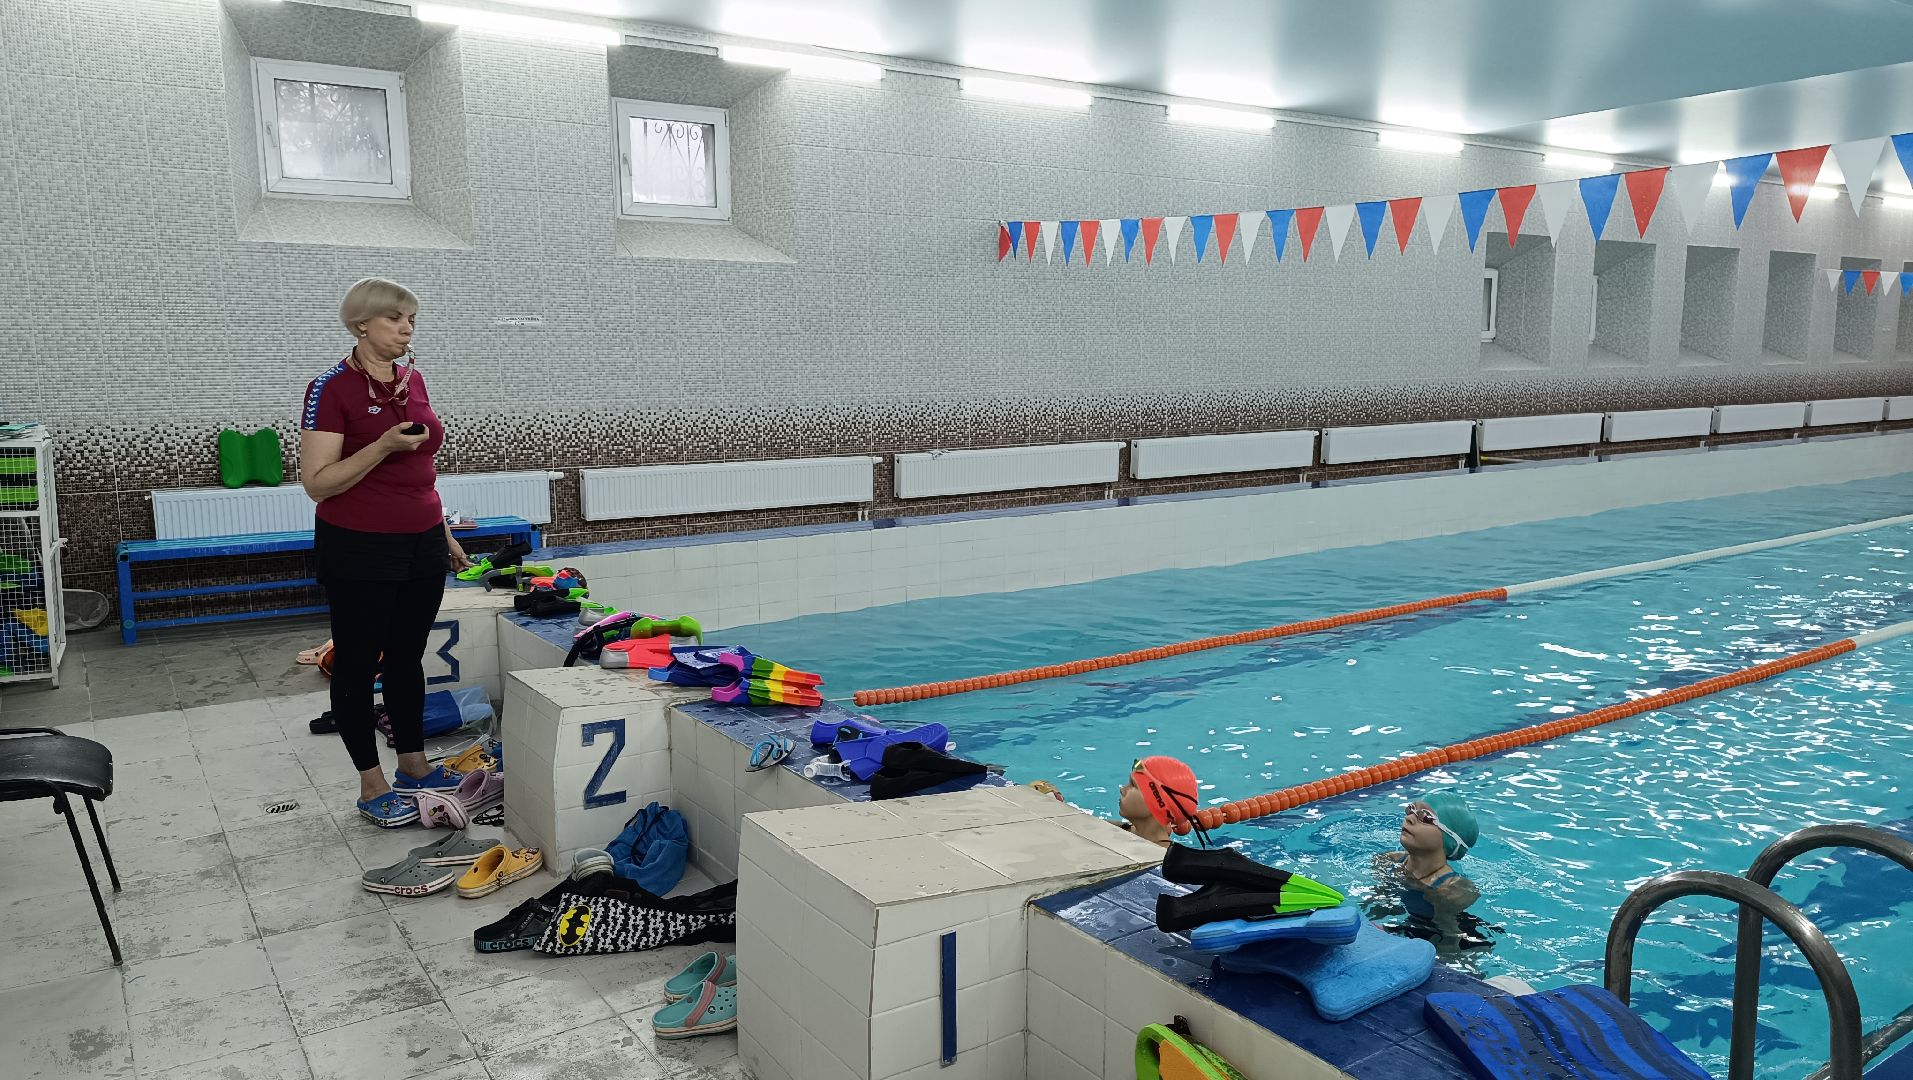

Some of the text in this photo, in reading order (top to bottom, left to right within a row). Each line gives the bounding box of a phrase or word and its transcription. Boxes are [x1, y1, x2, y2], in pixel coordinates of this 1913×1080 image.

[426, 620, 460, 685] 3
[581, 718, 627, 809] 2
[1148, 781, 1166, 809] arena
[394, 884, 429, 895] crocs
[489, 939, 530, 950] crocs
[940, 931, 957, 1066] 1
